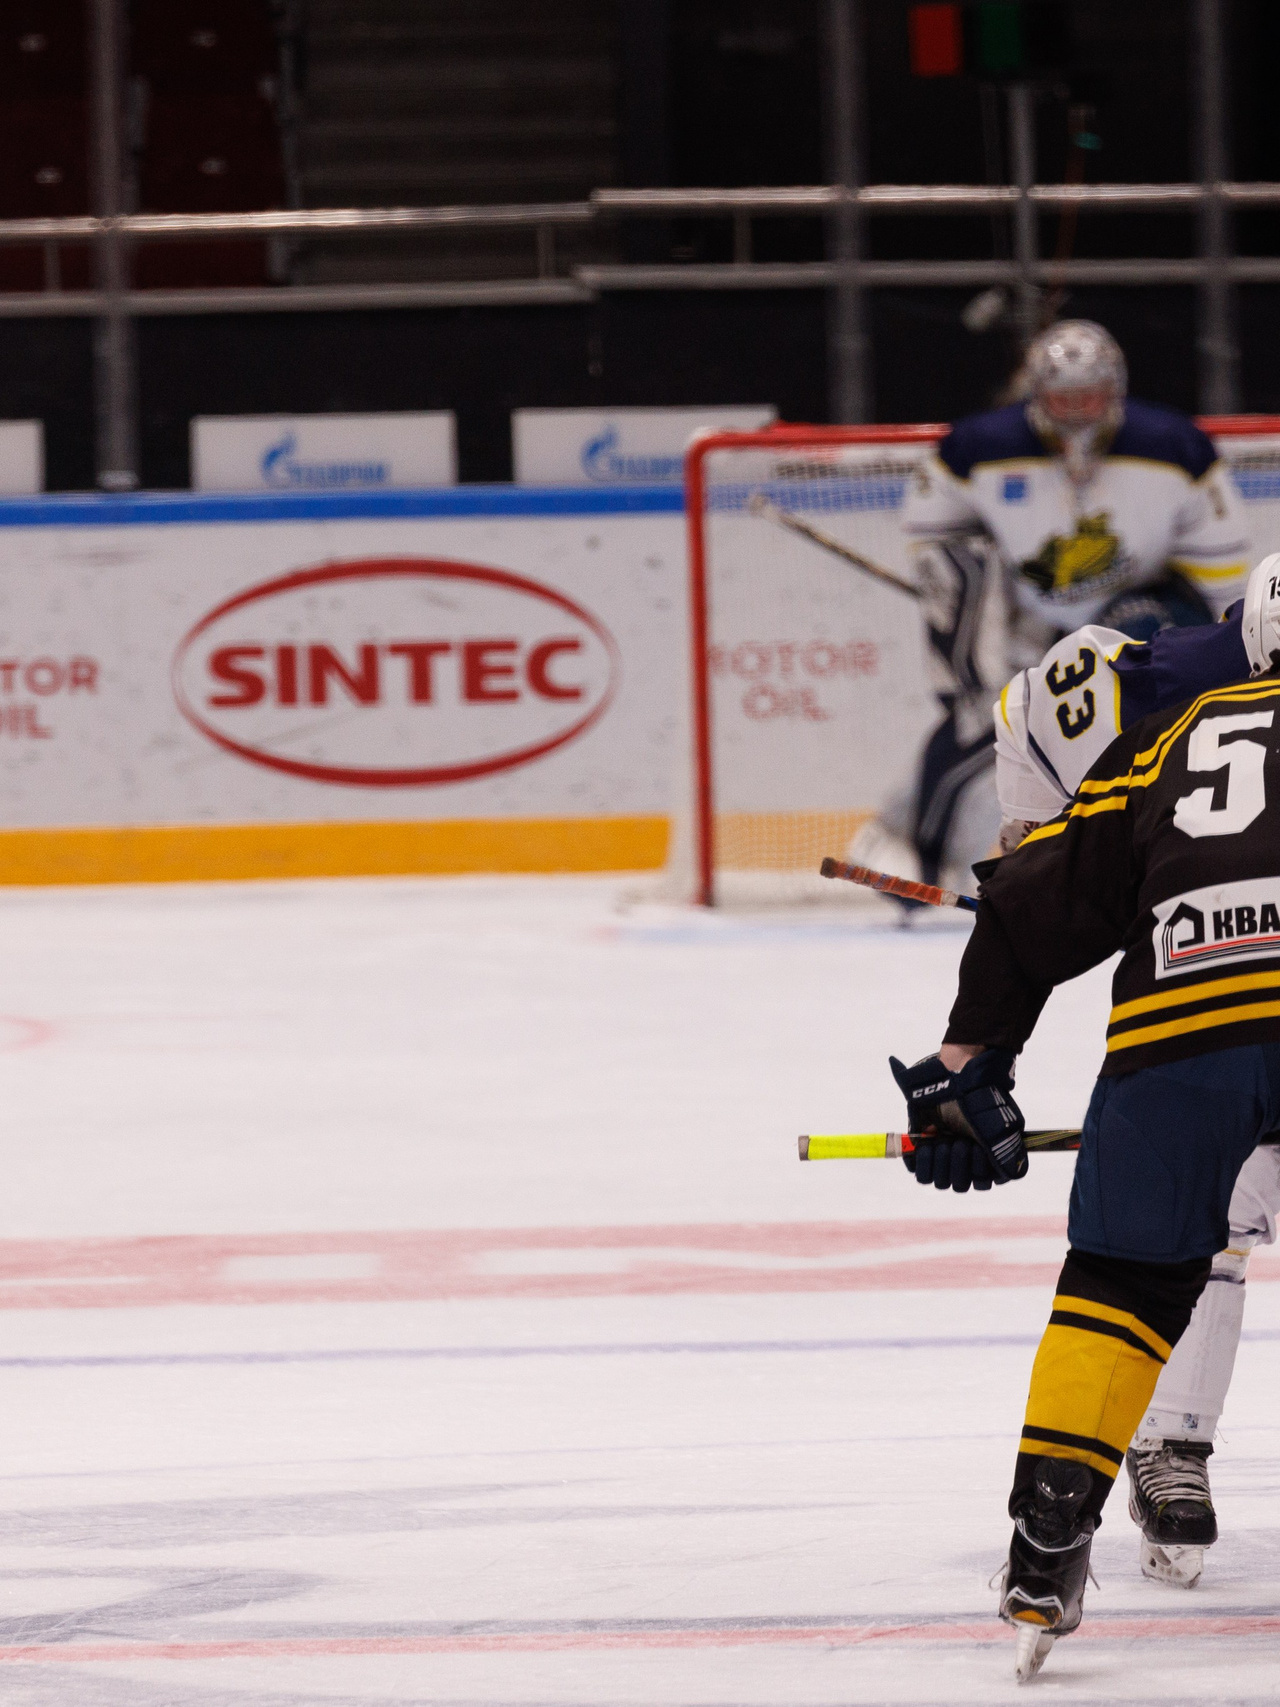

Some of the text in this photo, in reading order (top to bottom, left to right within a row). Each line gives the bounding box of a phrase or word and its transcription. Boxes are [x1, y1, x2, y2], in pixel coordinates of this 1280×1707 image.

[207, 639, 585, 708] SINTEC
[1045, 646, 1096, 740] 33
[0, 703, 54, 740] IL
[911, 1079, 950, 1099] CCM
